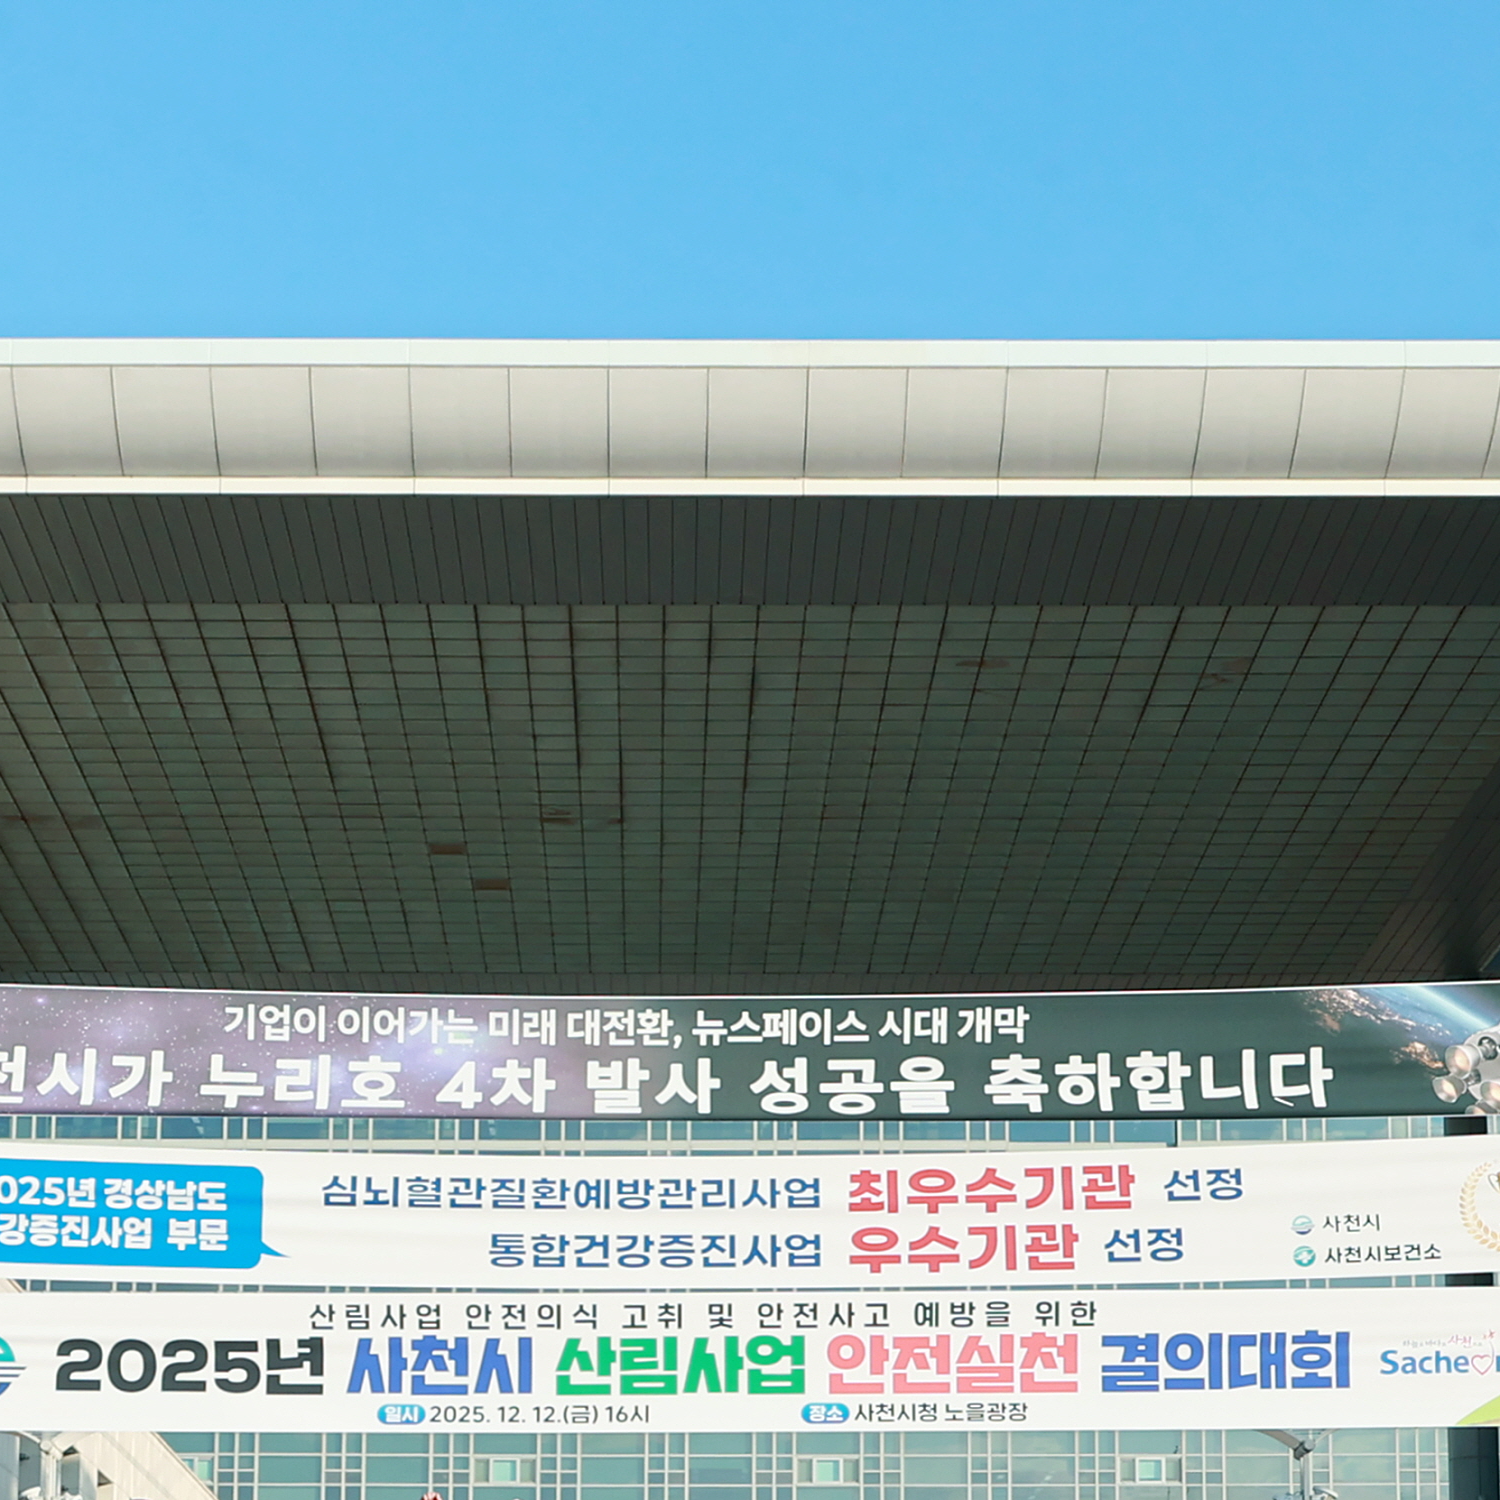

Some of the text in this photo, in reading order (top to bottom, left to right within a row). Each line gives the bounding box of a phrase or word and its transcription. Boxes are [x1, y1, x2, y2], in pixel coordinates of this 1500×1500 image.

[223, 1004, 1030, 1049] 기업이 이어가는 미래 대전환, 뉴스페이스 시대 개막
[199, 1053, 406, 1110] 누리호
[435, 1058, 556, 1114] 4차
[587, 1057, 720, 1115] 발사
[749, 1056, 955, 1115] 성공을
[984, 1046, 1334, 1113] 축하합니다
[103, 1178, 228, 1212] 경상남도
[322, 1164, 1244, 1214] 심뇌혈관질환예방관리사업 최우수기관 선정
[167, 1218, 229, 1252] 부문
[1322, 1213, 1381, 1233] 사천시
[488, 1223, 1185, 1273] 통합건강증진사업 우수기관 선정
[1324, 1243, 1443, 1265] 사천시보건소
[309, 1301, 1098, 1331] 산림사업 안전의식 고취 및 안전사고 예방을 위한
[55, 1330, 1351, 1396] 2025년 사천시 산림사업 안전실천 결의대회
[383, 1405, 420, 1424] 일시
[429, 1406, 491, 1424] 2025.
[498, 1406, 527, 1424] 12.
[605, 1404, 650, 1425] 16시
[807, 1402, 1028, 1424] 장소 사천시청 노을광장
